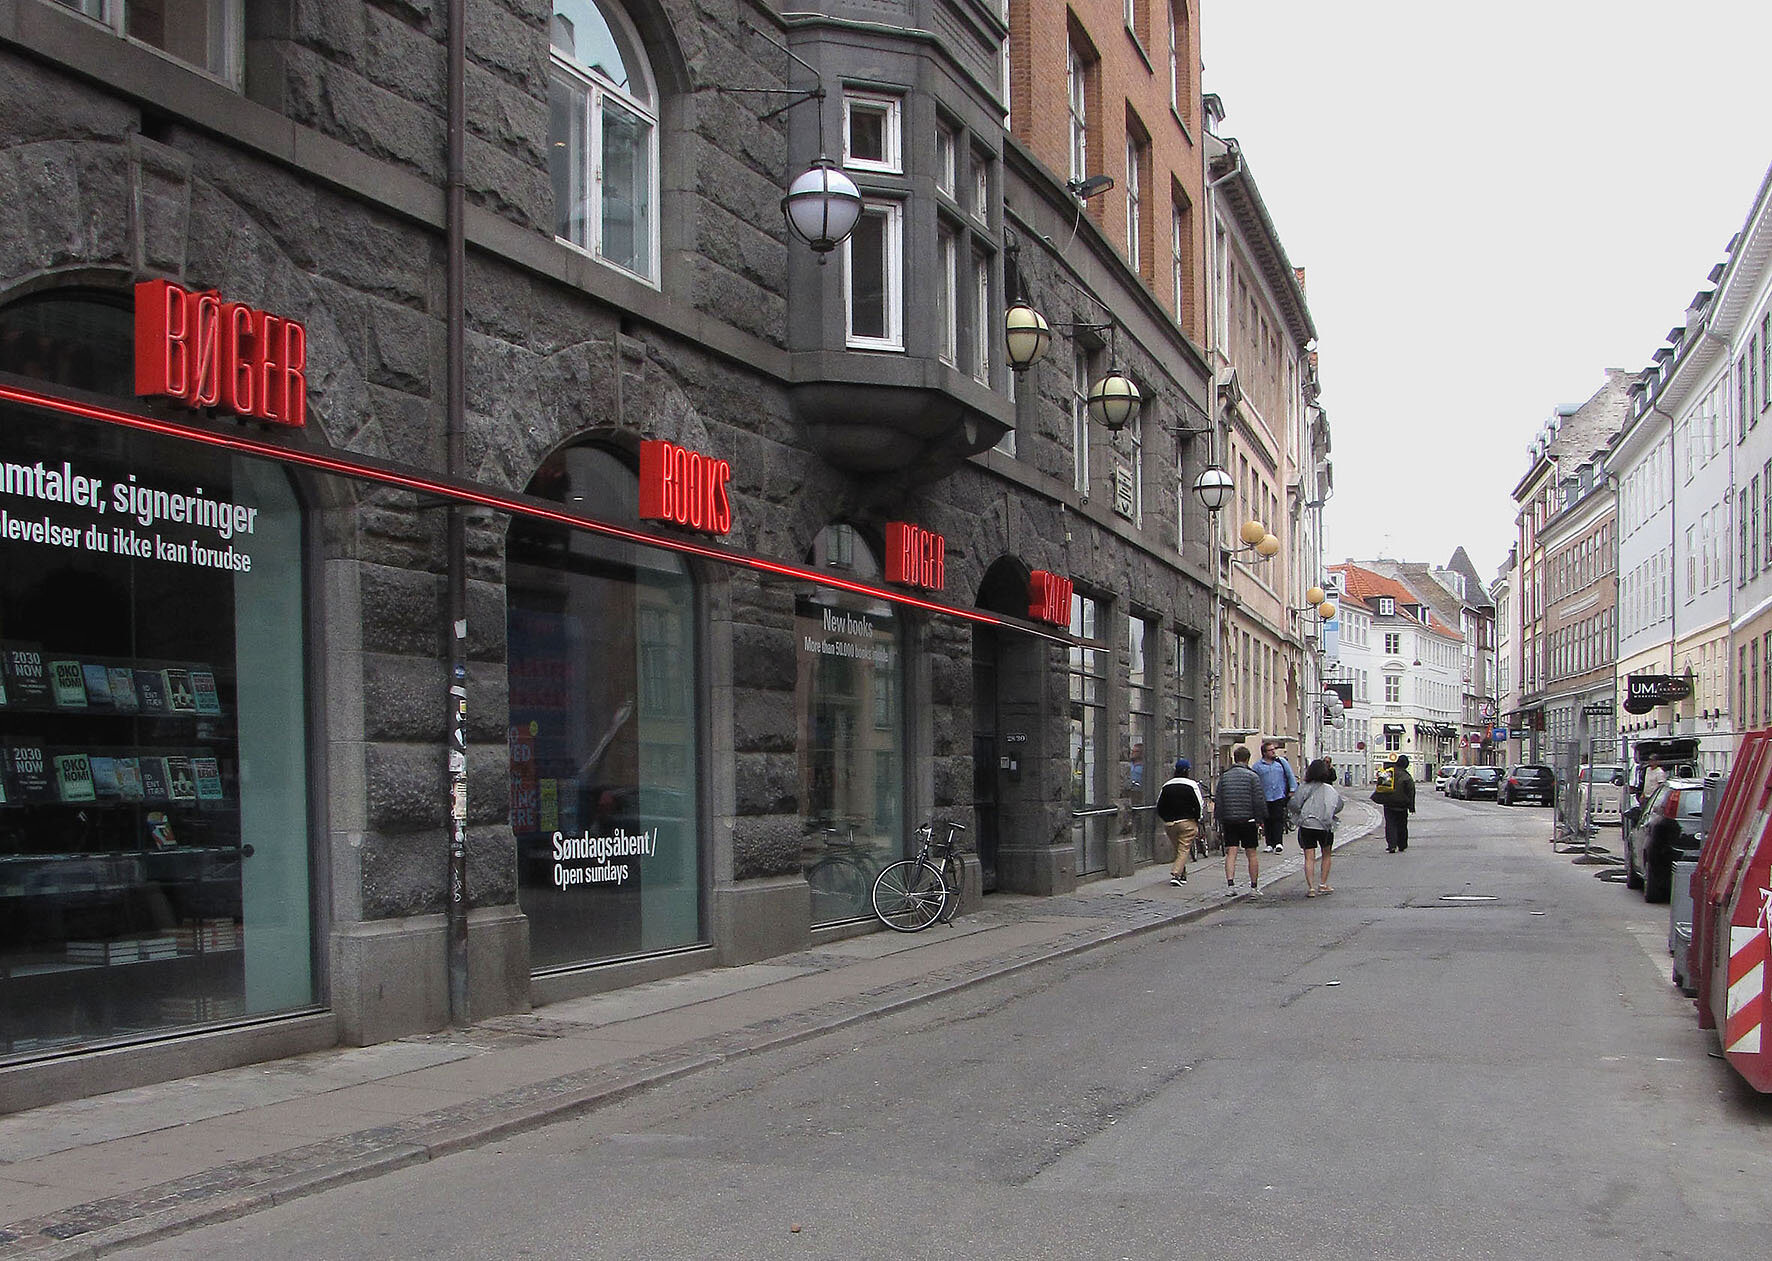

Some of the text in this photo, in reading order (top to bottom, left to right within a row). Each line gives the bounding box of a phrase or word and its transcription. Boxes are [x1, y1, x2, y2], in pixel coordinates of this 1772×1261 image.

[164, 284, 307, 428] BØGER
[661, 441, 731, 536] BOOKS
[113, 474, 258, 539] signeringer
[0, 510, 252, 573] levelser du ikke kan forudse
[901, 523, 945, 592] BØGER
[823, 607, 874, 638] New books
[804, 636, 821, 654] More
[821, 638, 836, 656] than
[12, 650, 41, 665] 2030
[15, 663, 43, 678] NOW
[56, 664, 80, 677] ØKO
[58, 677, 82, 688] NOMI
[13, 746, 43, 761] 2030
[16, 760, 44, 774] NOW
[62, 758, 87, 772] ØKO
[64, 770, 90, 782] NOMI
[552, 828, 650, 864] Søndagsåbent
[554, 860, 629, 891] Open sundays
